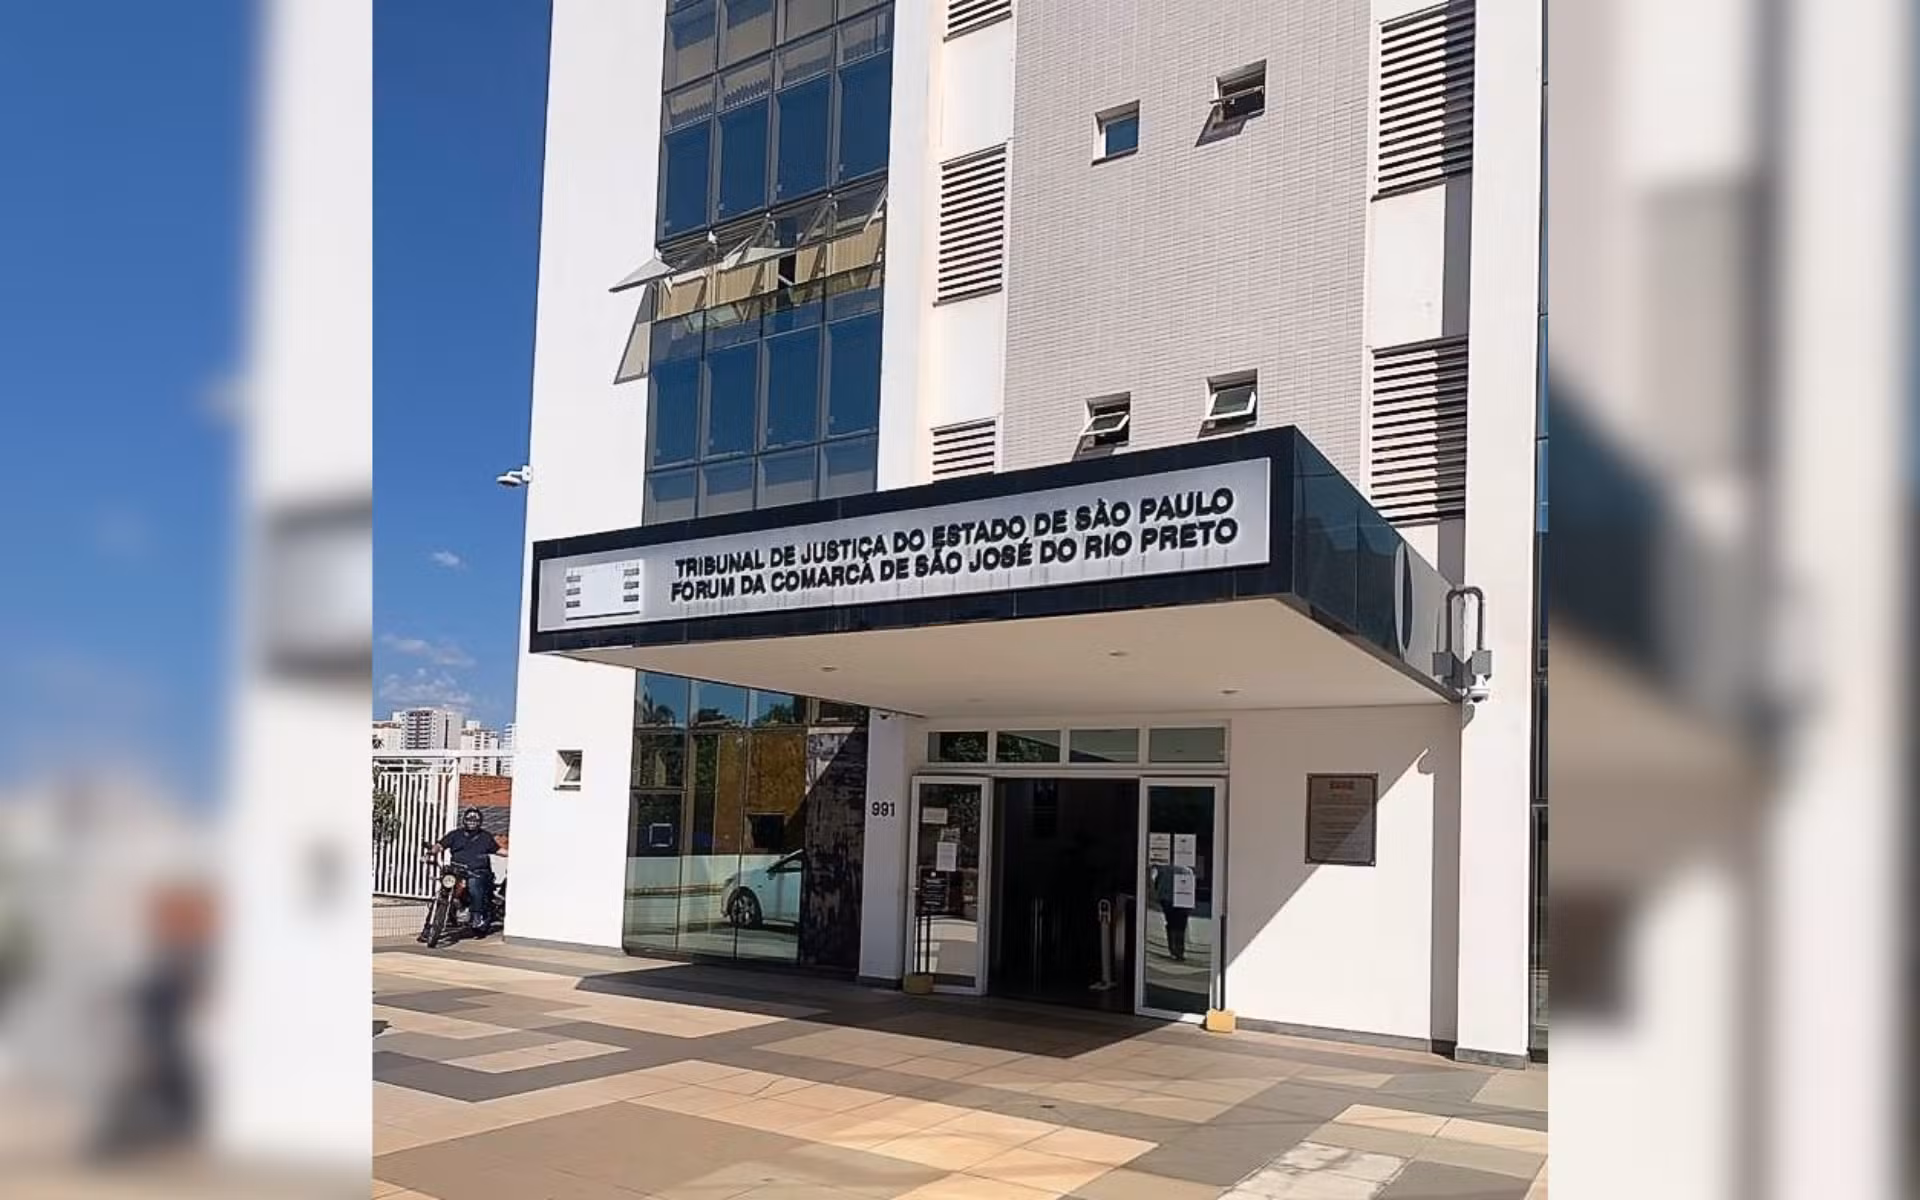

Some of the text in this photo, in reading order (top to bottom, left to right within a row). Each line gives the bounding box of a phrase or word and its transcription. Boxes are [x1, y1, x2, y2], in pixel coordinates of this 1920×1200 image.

[675, 487, 1235, 578] TRIBUNAL DE JUSTIÇA DO ESTADO DE SÃO PAULO
[741, 573, 766, 595] DA
[771, 561, 874, 593] COMARCA
[880, 558, 909, 581] DE
[914, 548, 963, 577] SÃO
[969, 538, 1032, 572] JOSÉ
[1039, 538, 1078, 564] DO
[1084, 530, 1133, 560] RIO
[1140, 517, 1238, 552] PRETO
[872, 801, 895, 817] 991
